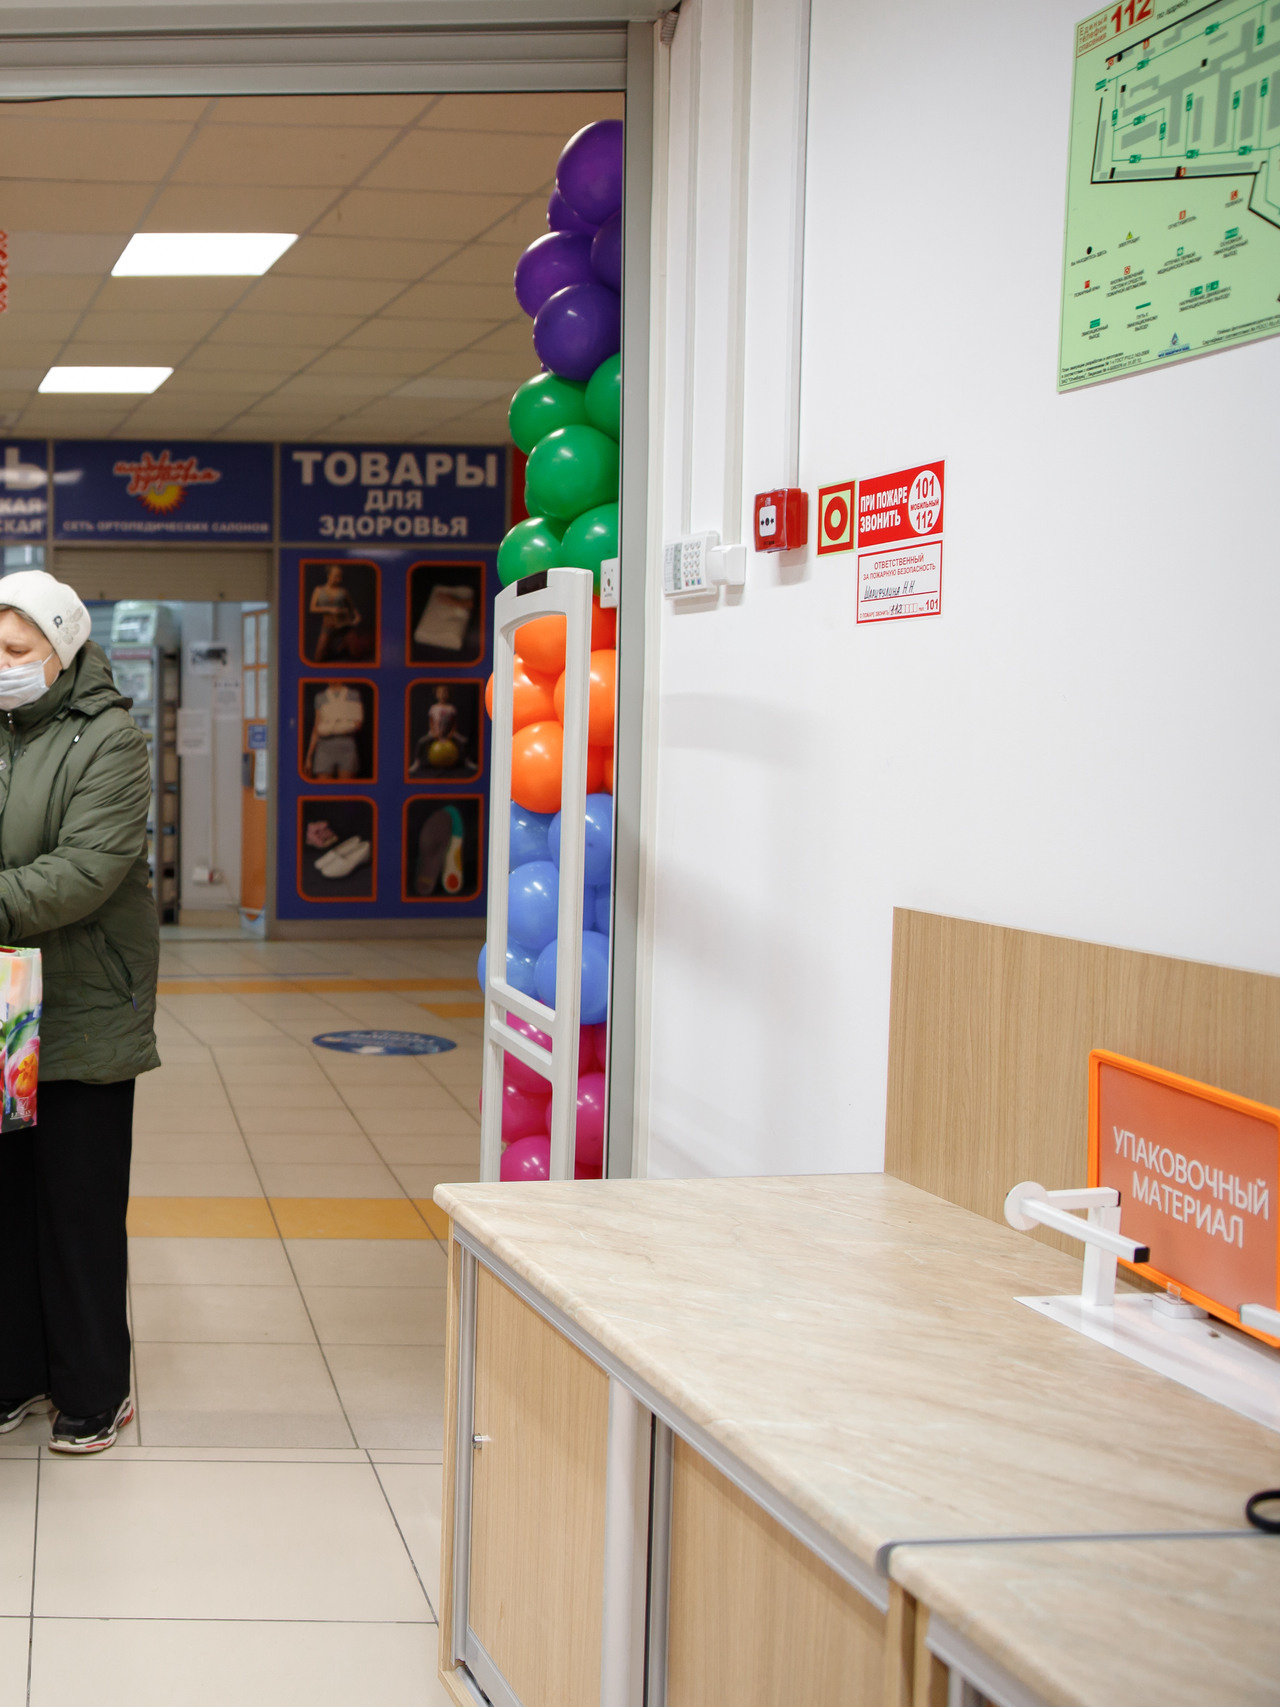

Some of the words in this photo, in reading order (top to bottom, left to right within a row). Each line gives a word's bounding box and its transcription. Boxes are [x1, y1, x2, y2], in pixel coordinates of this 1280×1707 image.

[1111, 0, 1152, 33] 112
[292, 450, 498, 488] ТОВАРЫ
[915, 475, 935, 500] 101
[364, 490, 423, 512] ДЛЯ
[860, 494, 875, 513] ПРИ
[876, 486, 908, 510] ПОЖАРЕ
[910, 497, 939, 511] МОБИЛЬНЫЙ
[319, 515, 468, 538] ЗДОРОВЬЯ
[859, 509, 901, 533] ЗВОНИТЬ
[915, 509, 933, 530] 112
[863, 573, 869, 581] ЗА
[870, 569, 896, 579] ПОЖАРНУЮ
[897, 563, 936, 576] БЕЗОПАСНОСТЬ
[874, 552, 924, 570] ОТВЕТСТВЕННЫЙ
[926, 598, 938, 611] 101
[1112, 1125, 1269, 1220] УПАКОВОЧНЫЙ
[1132, 1170, 1244, 1249] МАТЕРИАЛ
